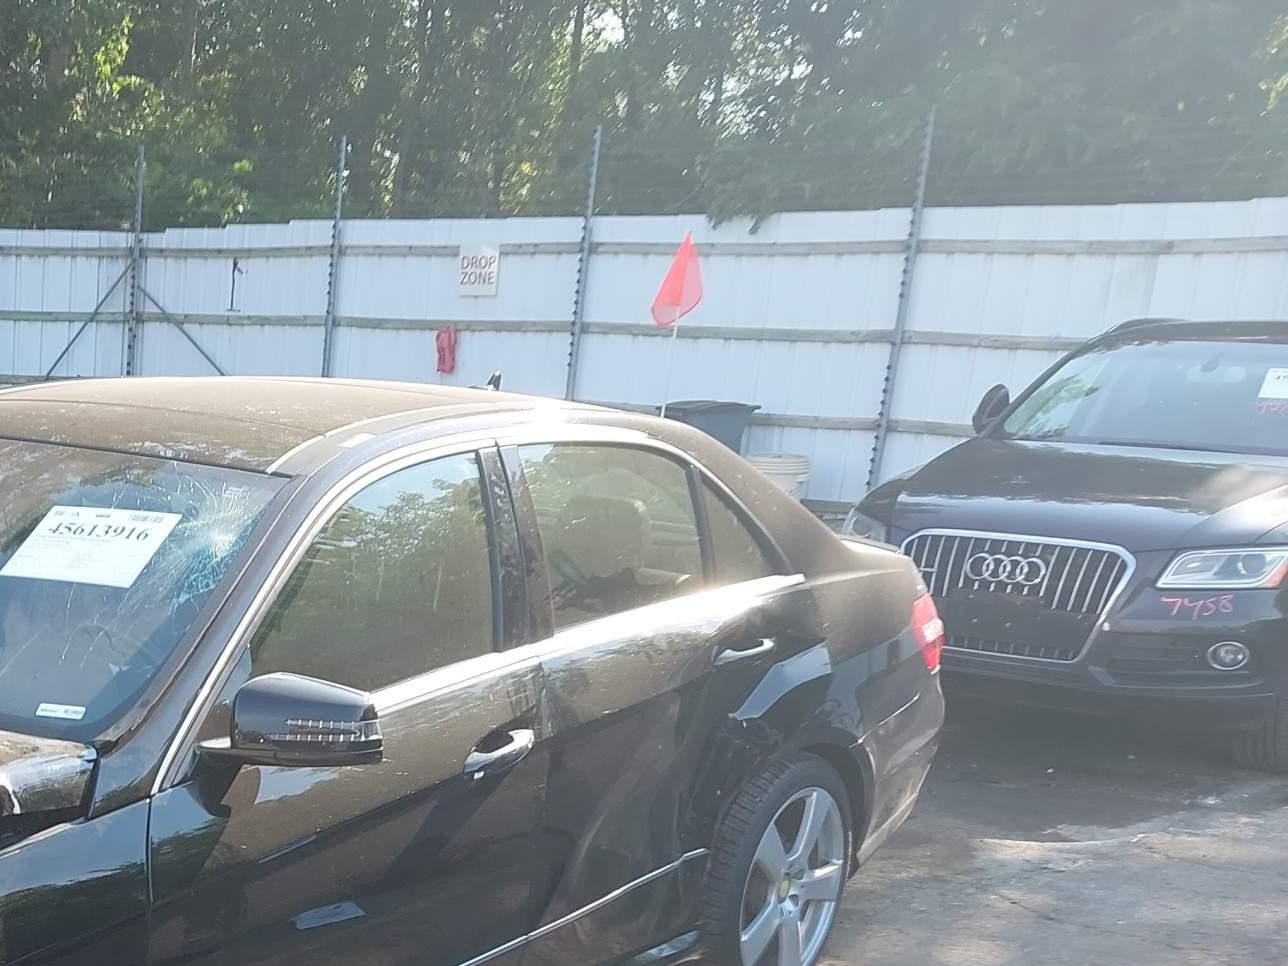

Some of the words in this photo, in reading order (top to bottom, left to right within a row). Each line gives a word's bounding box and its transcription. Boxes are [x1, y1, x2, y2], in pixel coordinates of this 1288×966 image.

[461, 255, 497, 270] DROP
[459, 271, 495, 286] ZONE
[48, 521, 152, 541] 45613916
